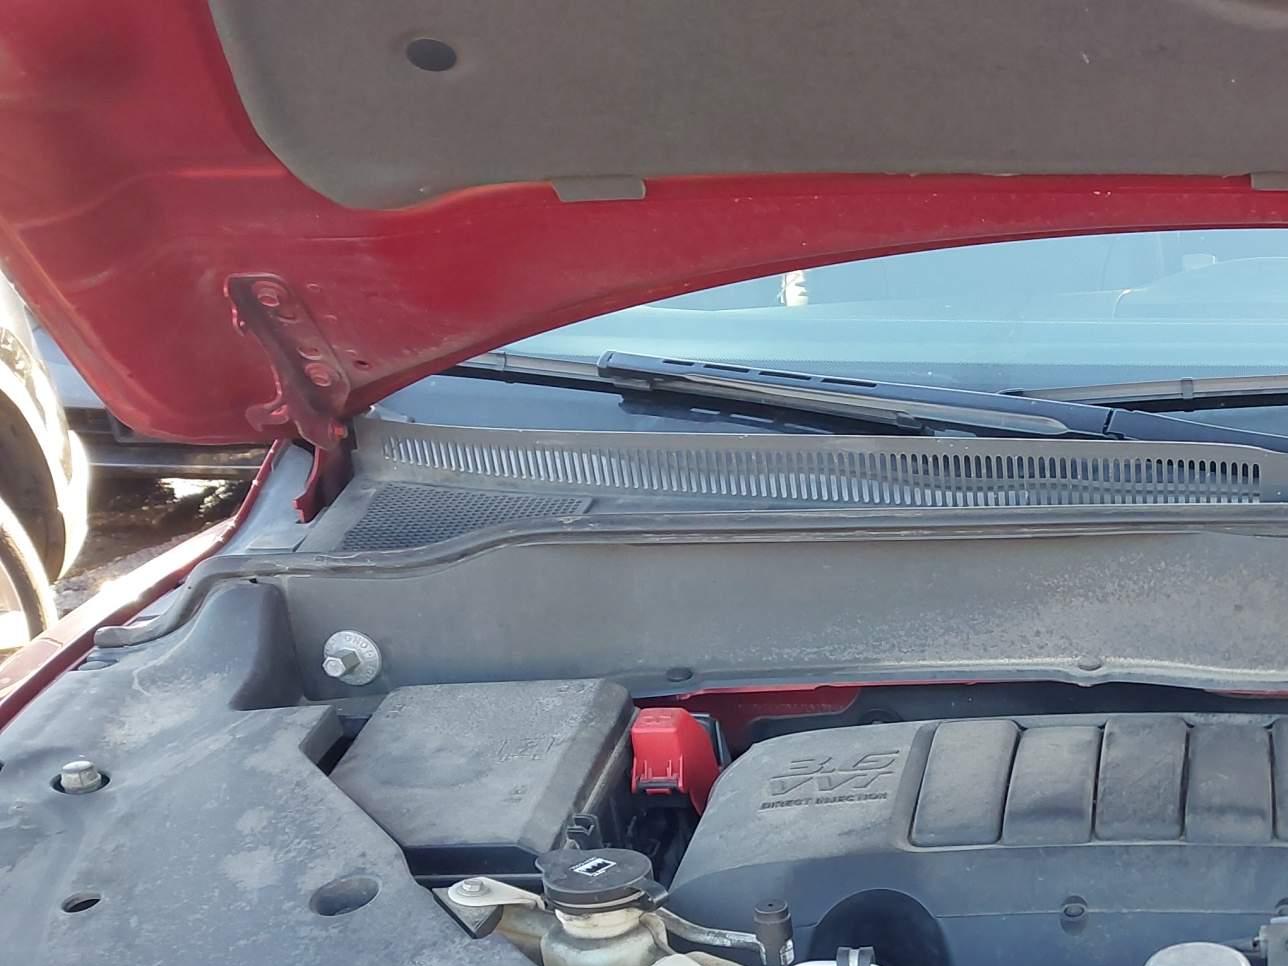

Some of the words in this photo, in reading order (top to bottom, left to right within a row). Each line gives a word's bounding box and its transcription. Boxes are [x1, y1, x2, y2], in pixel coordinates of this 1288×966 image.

[776, 750, 900, 777] 3.6
[769, 771, 895, 796] VVT
[760, 798, 813, 810] DIRECT
[815, 792, 888, 805] INJECTION
